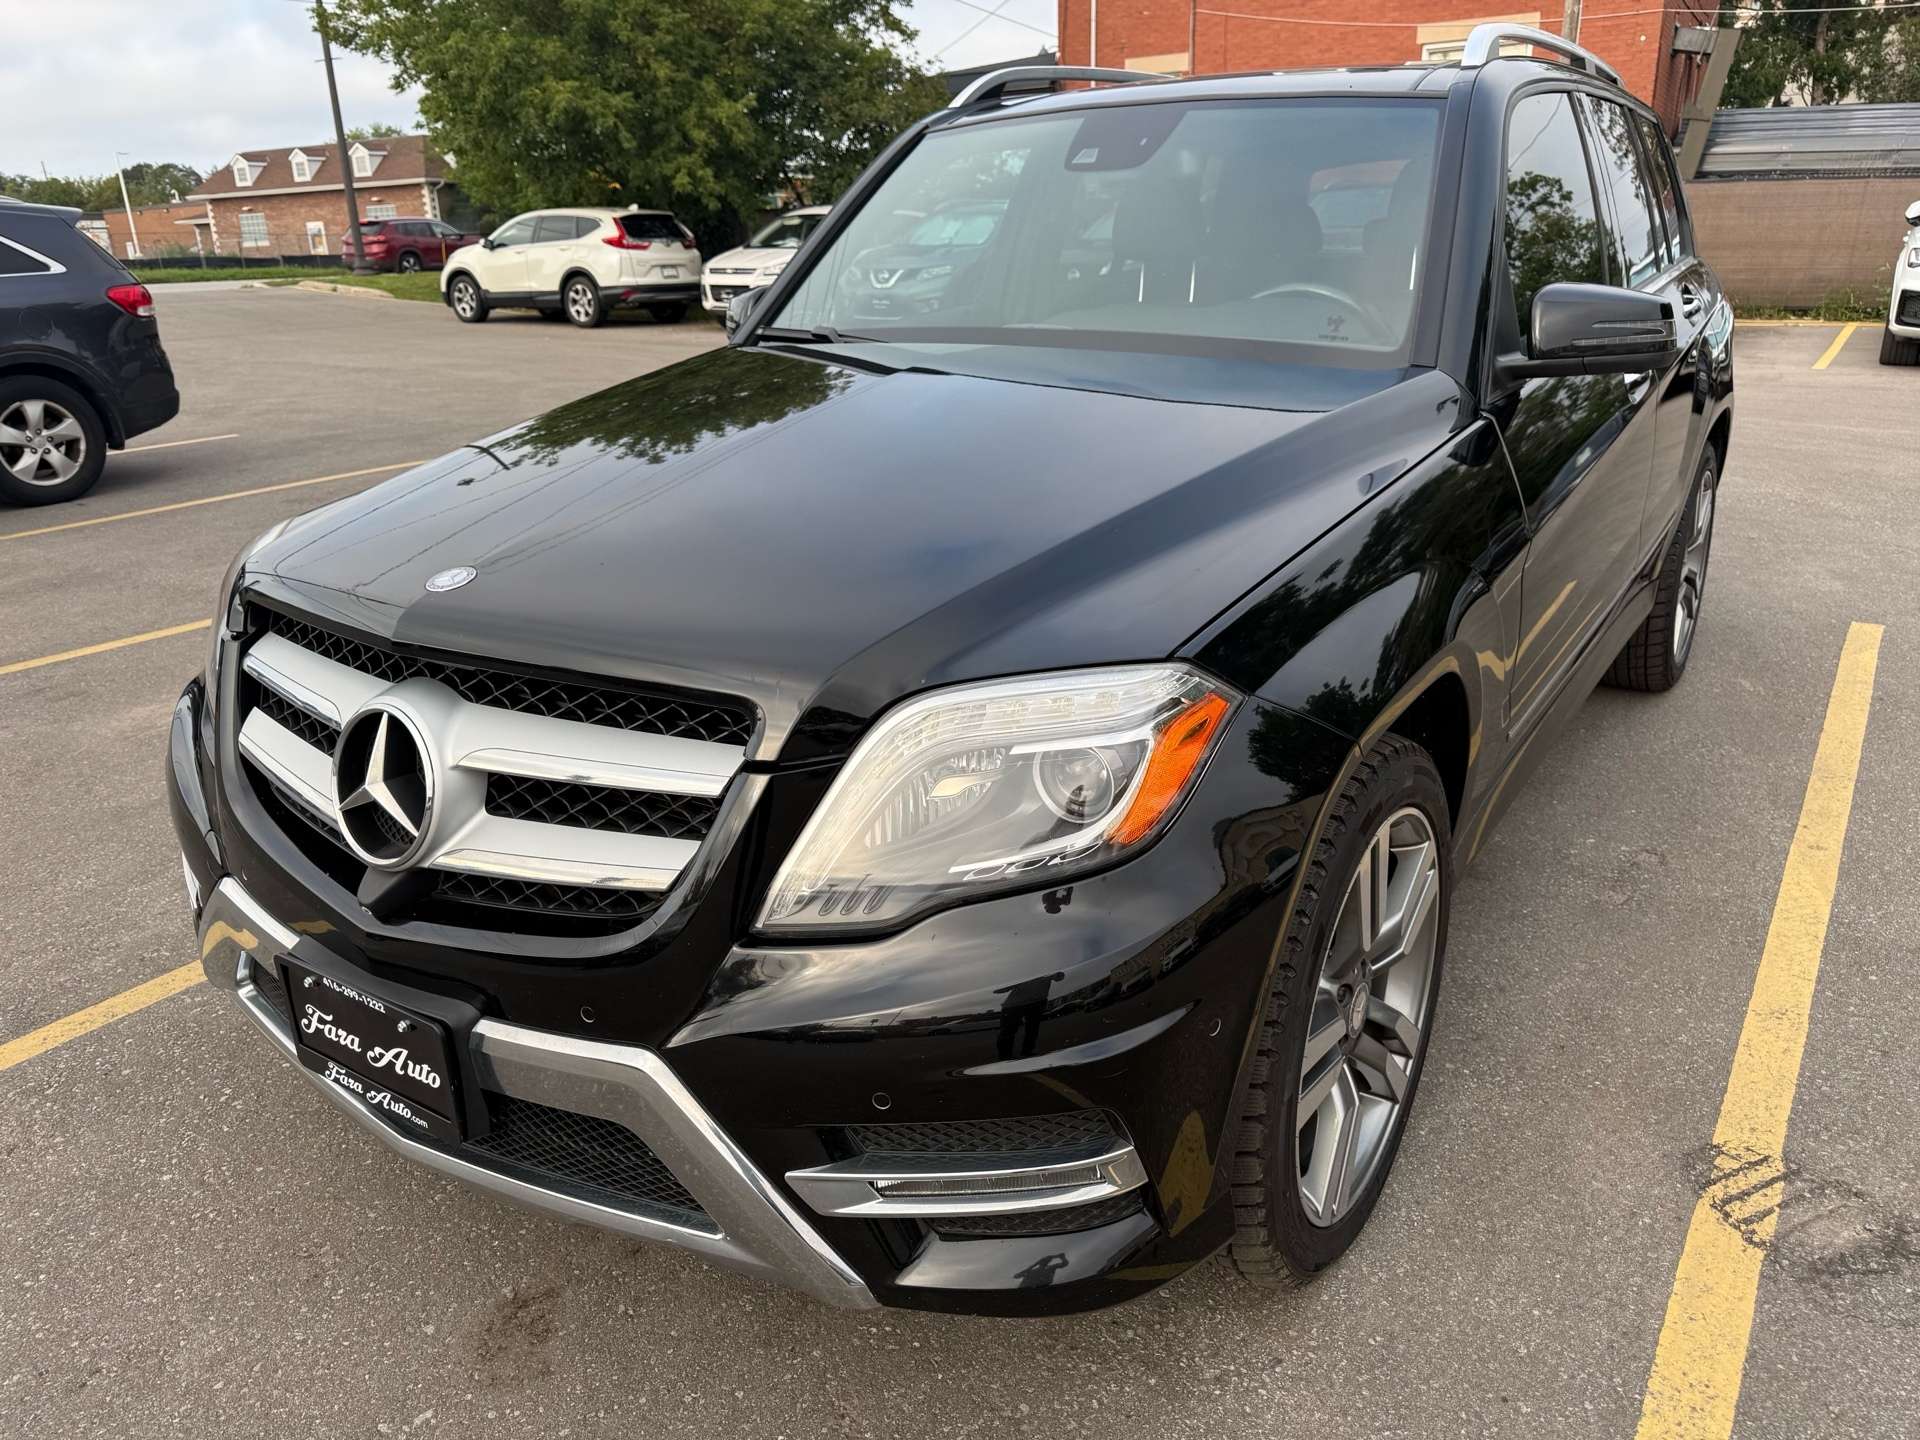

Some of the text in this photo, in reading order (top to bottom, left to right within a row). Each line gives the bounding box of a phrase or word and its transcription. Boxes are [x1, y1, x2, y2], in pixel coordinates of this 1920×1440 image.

[323, 977, 386, 1014] 416-299-1222
[301, 1004, 441, 1088] Fara Auto
[325, 1062, 364, 1094] Fara
